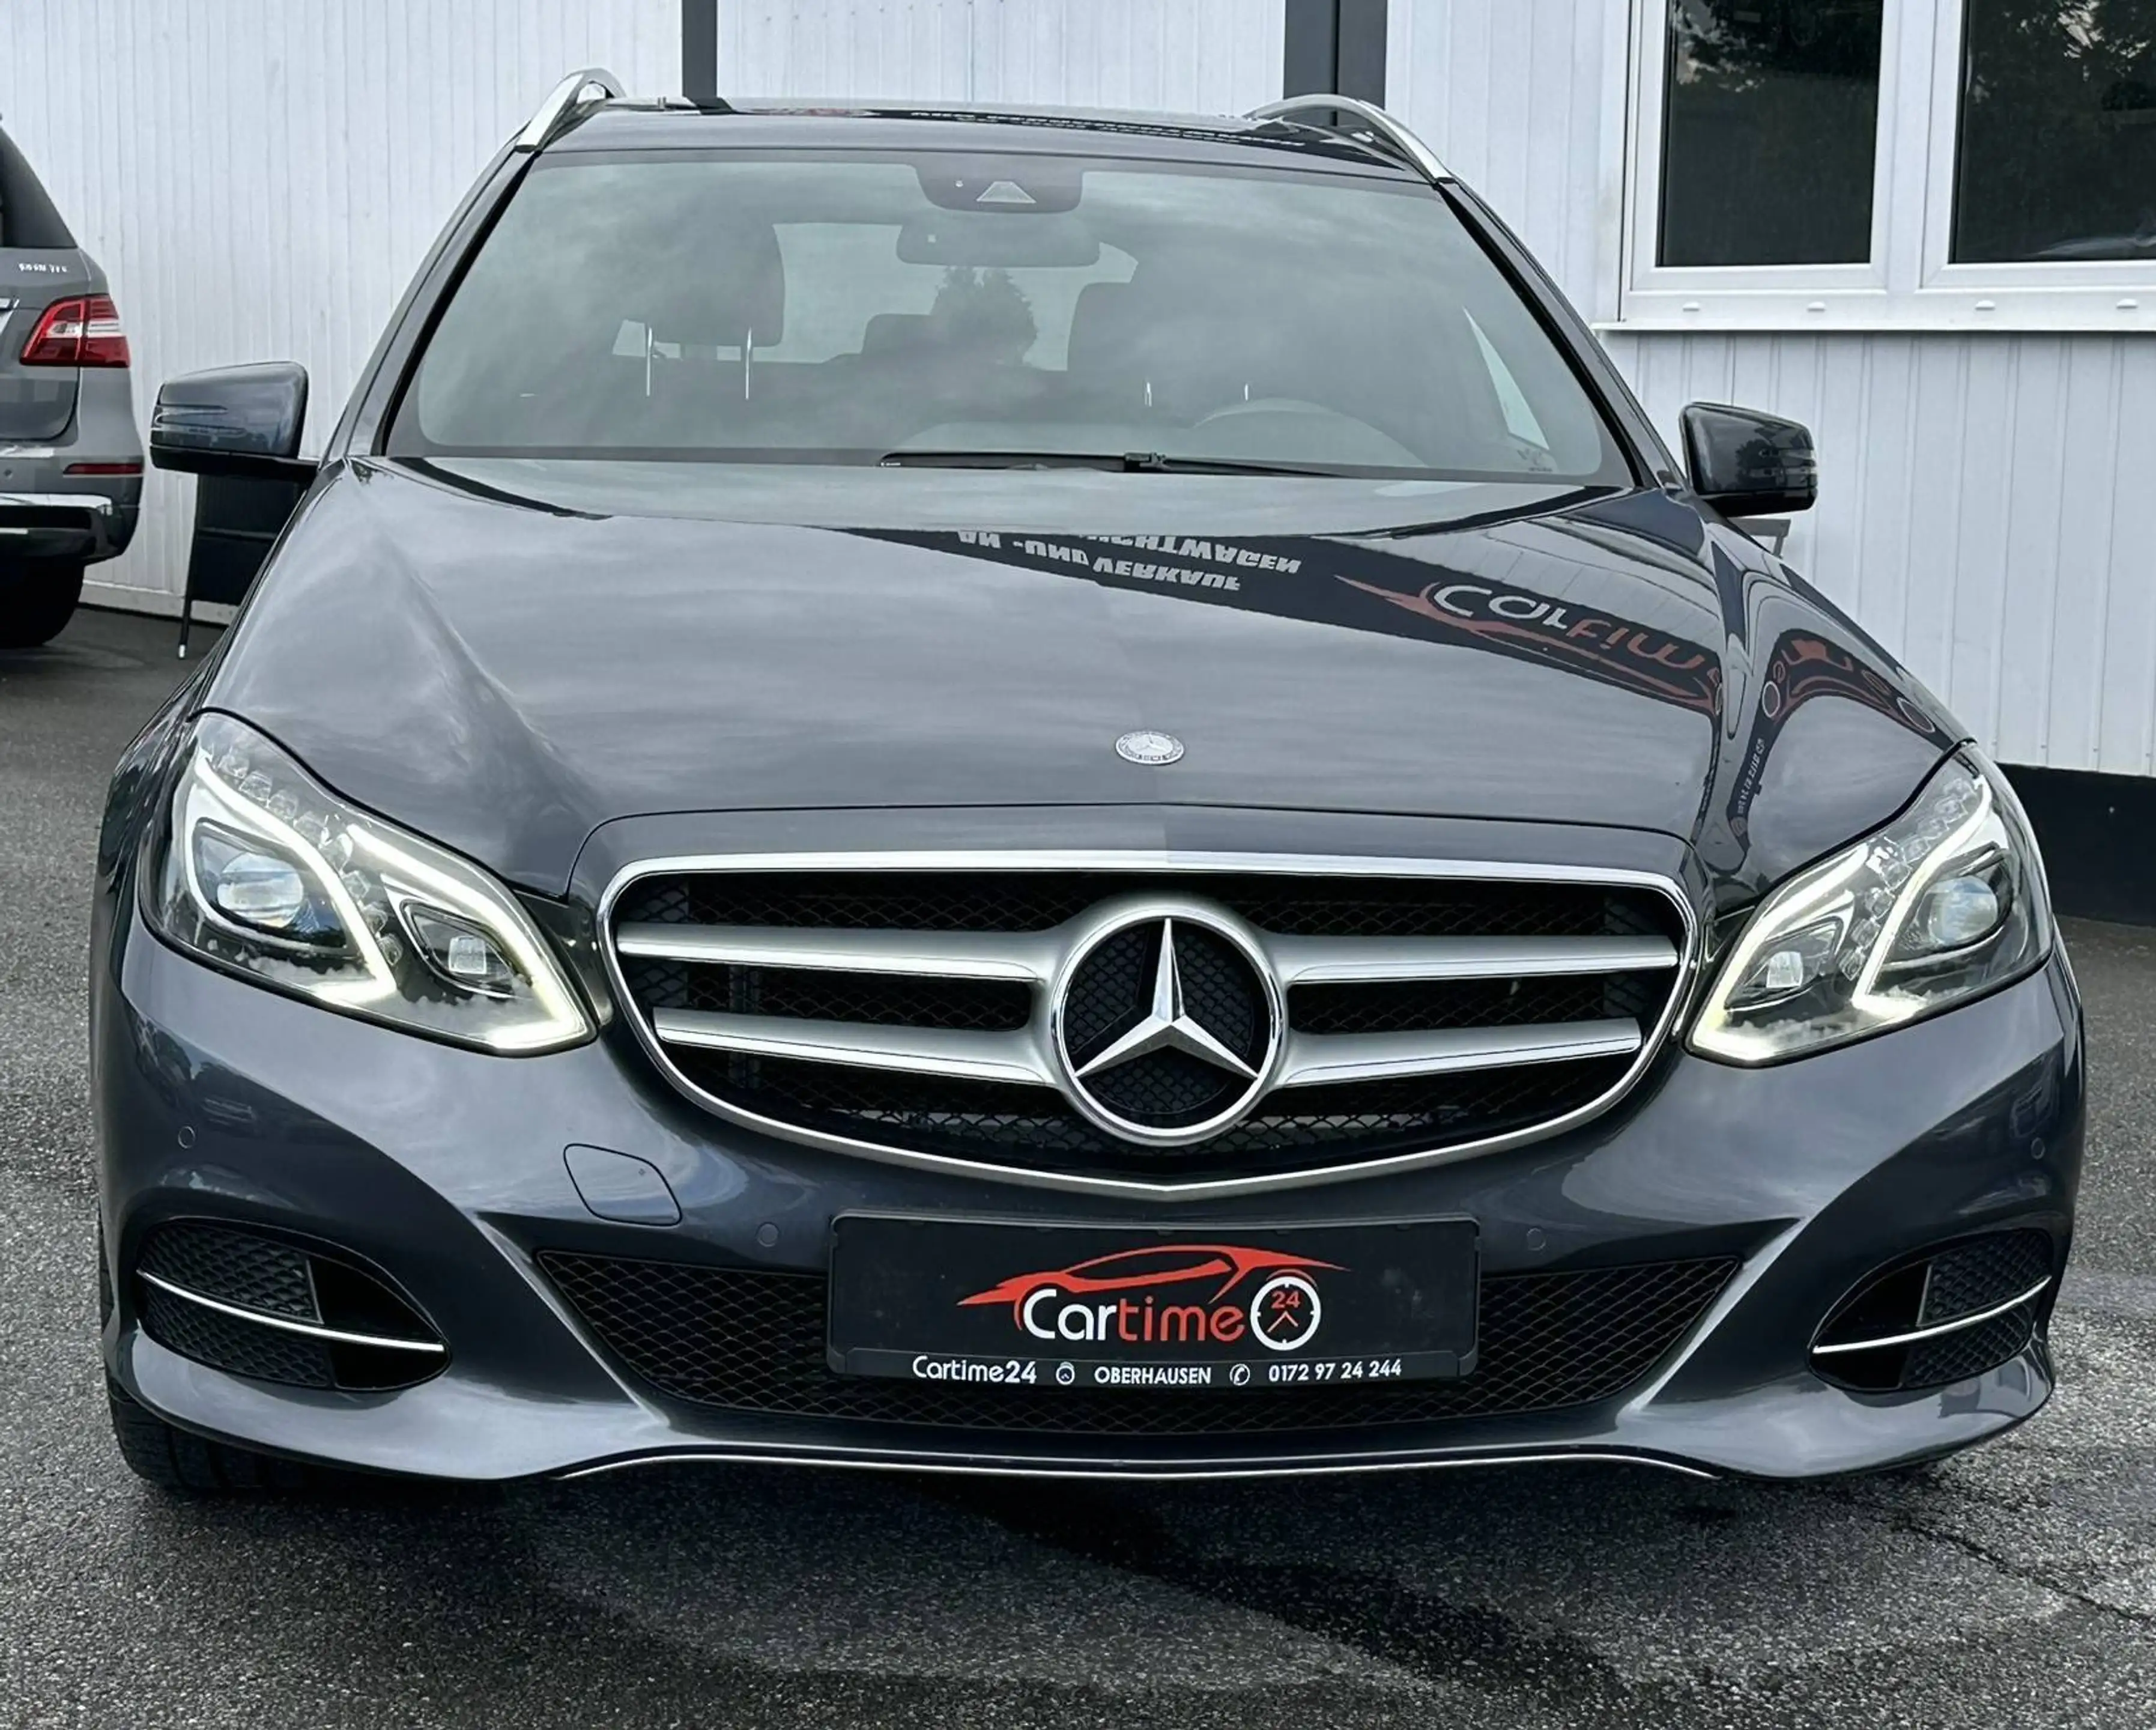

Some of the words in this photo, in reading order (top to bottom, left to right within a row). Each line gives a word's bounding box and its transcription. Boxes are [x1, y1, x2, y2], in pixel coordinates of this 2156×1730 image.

[1271, 1290, 1300, 1308] 24
[1023, 1288, 1245, 1341] Cartime
[912, 1356, 1037, 1384] Cartime24
[1094, 1366, 1211, 1384] OBERHAUSEN
[1268, 1364, 1309, 1382] 0172
[1315, 1362, 1336, 1380] 97
[1340, 1362, 1363, 1379] 24
[1369, 1359, 1402, 1377] 244
